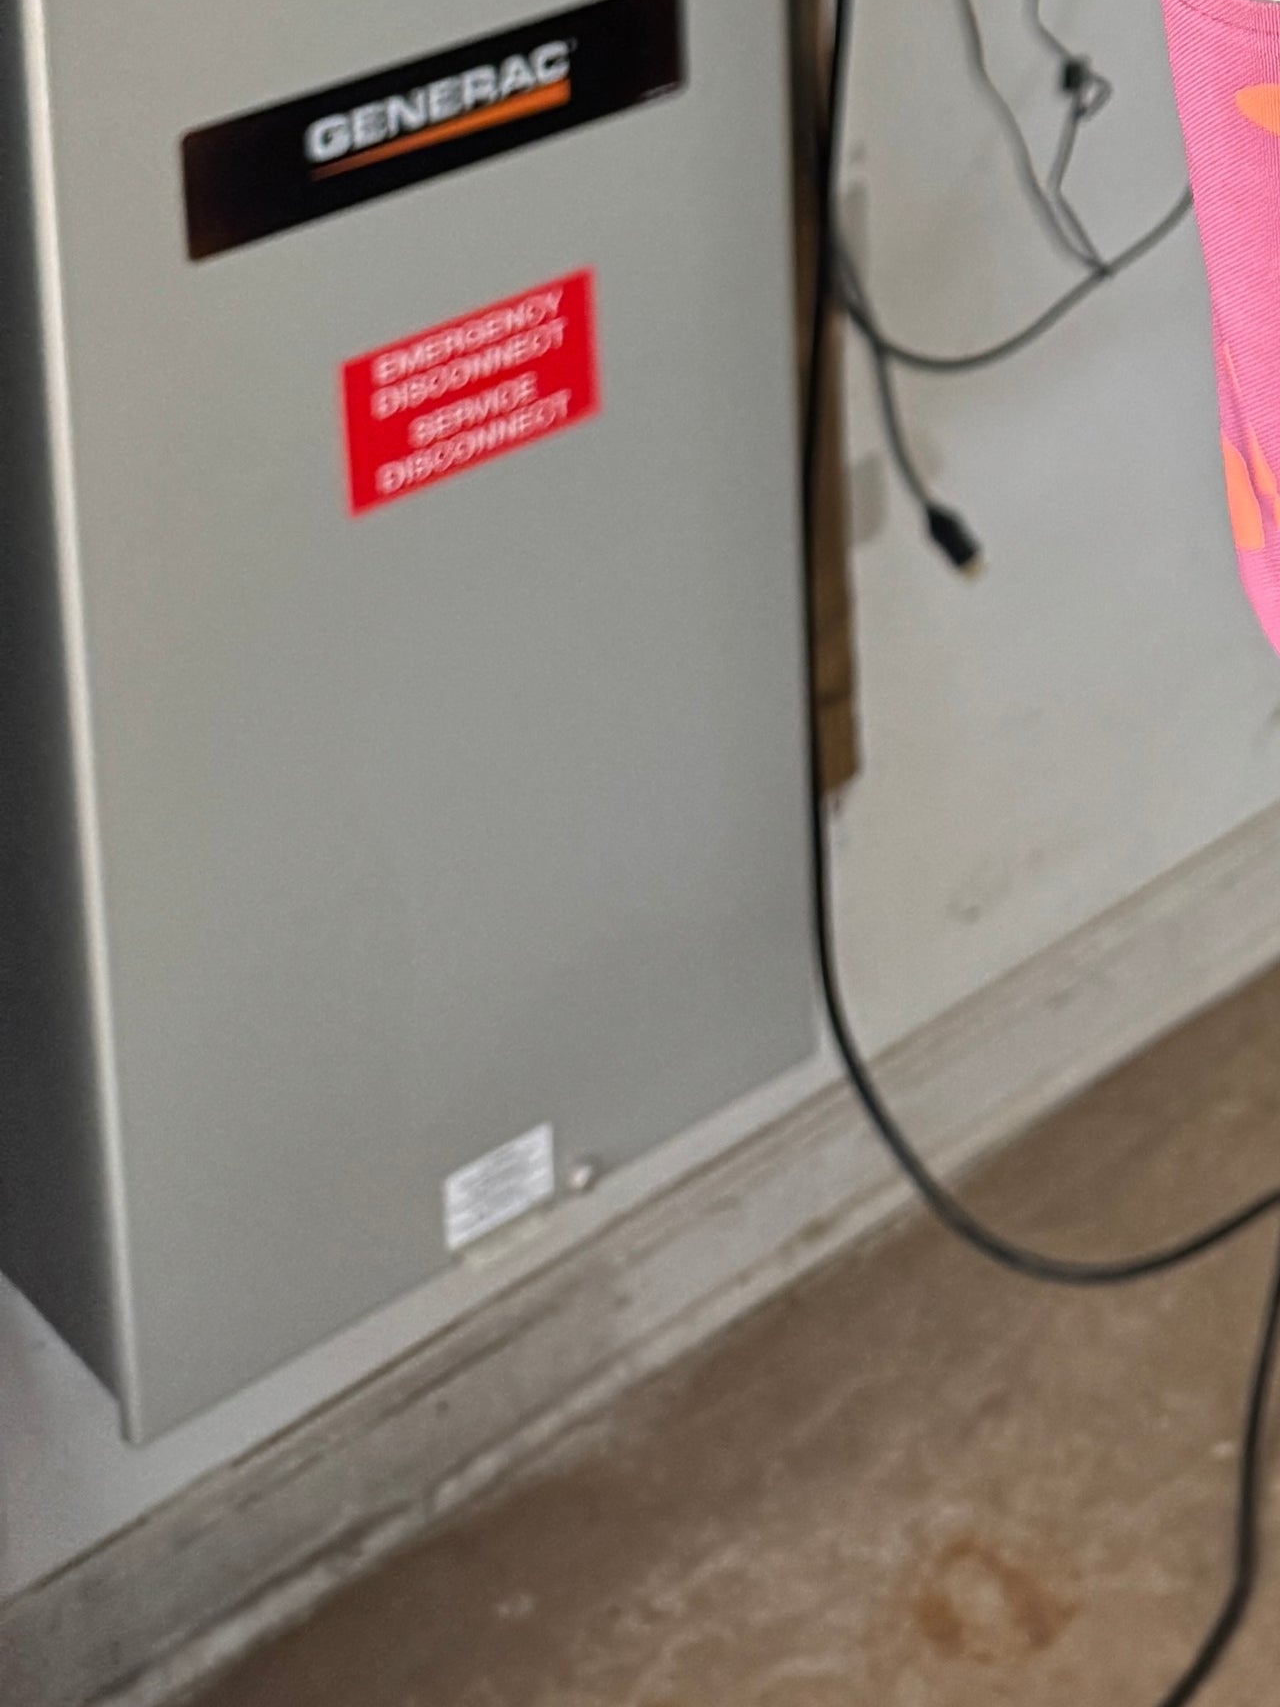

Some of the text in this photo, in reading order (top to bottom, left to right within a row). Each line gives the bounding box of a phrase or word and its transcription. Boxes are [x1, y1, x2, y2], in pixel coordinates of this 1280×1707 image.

[305, 39, 571, 163] GENERAC
[370, 316, 569, 421] DISCONNECT
[371, 289, 564, 387] EMERGENCY
[375, 388, 571, 494] DISCONNECT
[408, 371, 537, 450] SERVICE
